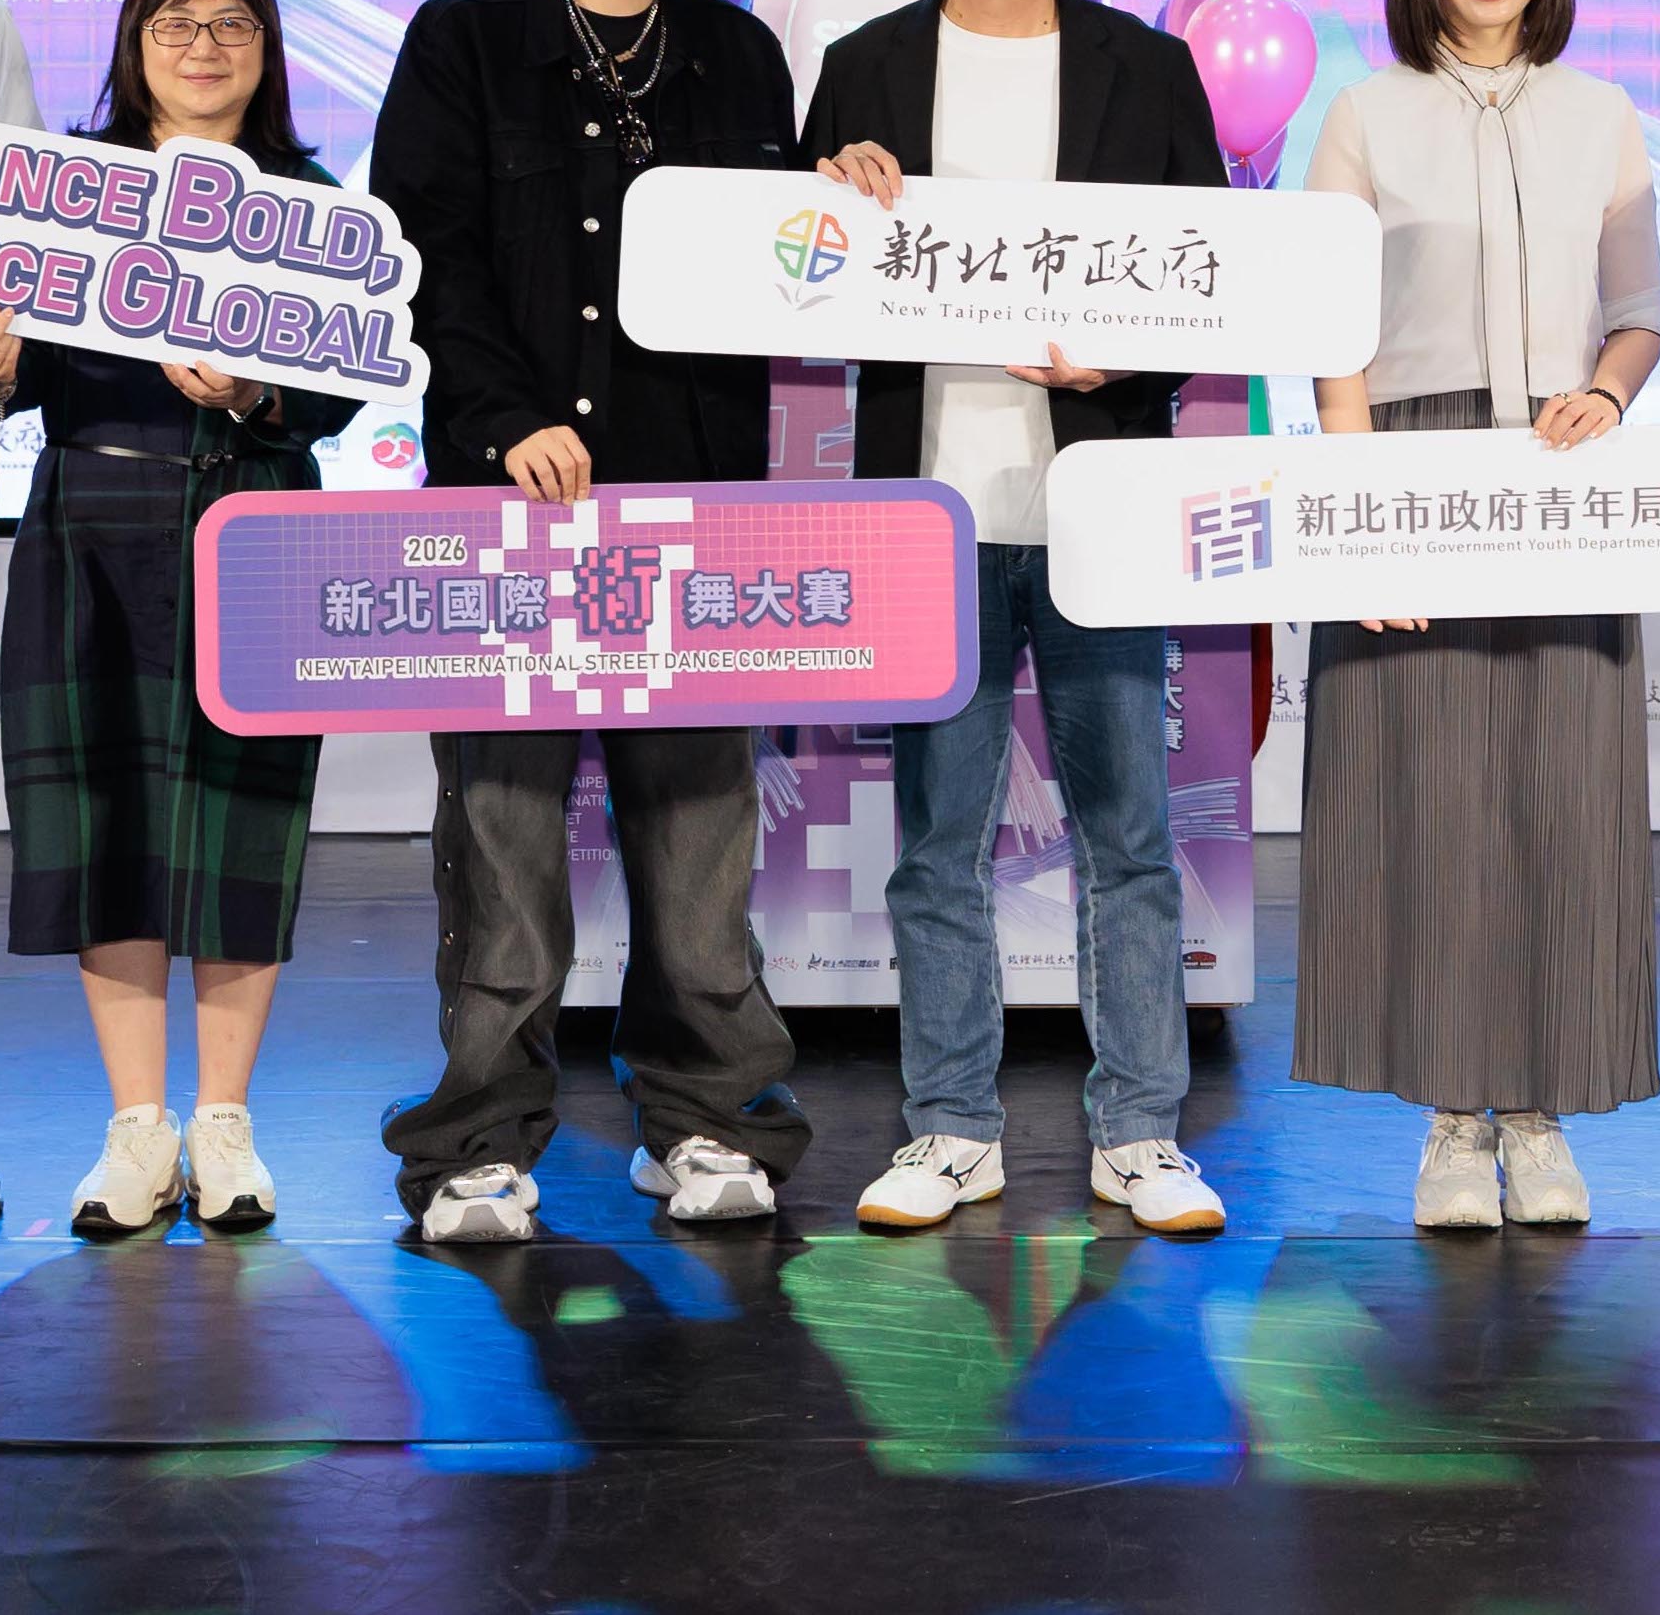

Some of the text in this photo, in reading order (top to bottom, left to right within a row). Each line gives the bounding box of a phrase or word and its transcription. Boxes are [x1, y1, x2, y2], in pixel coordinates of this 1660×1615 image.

[873, 220, 1220, 297] 新北市政府
[102, 243, 409, 386] GLOBAL
[880, 301, 1225, 329] New Taipei City Government
[407, 536, 466, 563] 2026
[1298, 544, 1332, 557] New
[1338, 542, 1384, 558] Taipei
[1390, 541, 1421, 558] City
[1426, 539, 1522, 554] Government
[1528, 537, 1572, 552] Youth
[298, 648, 872, 677] NEW TAIPEI INTERNATIONAL STREET DANCE COMPETITION
